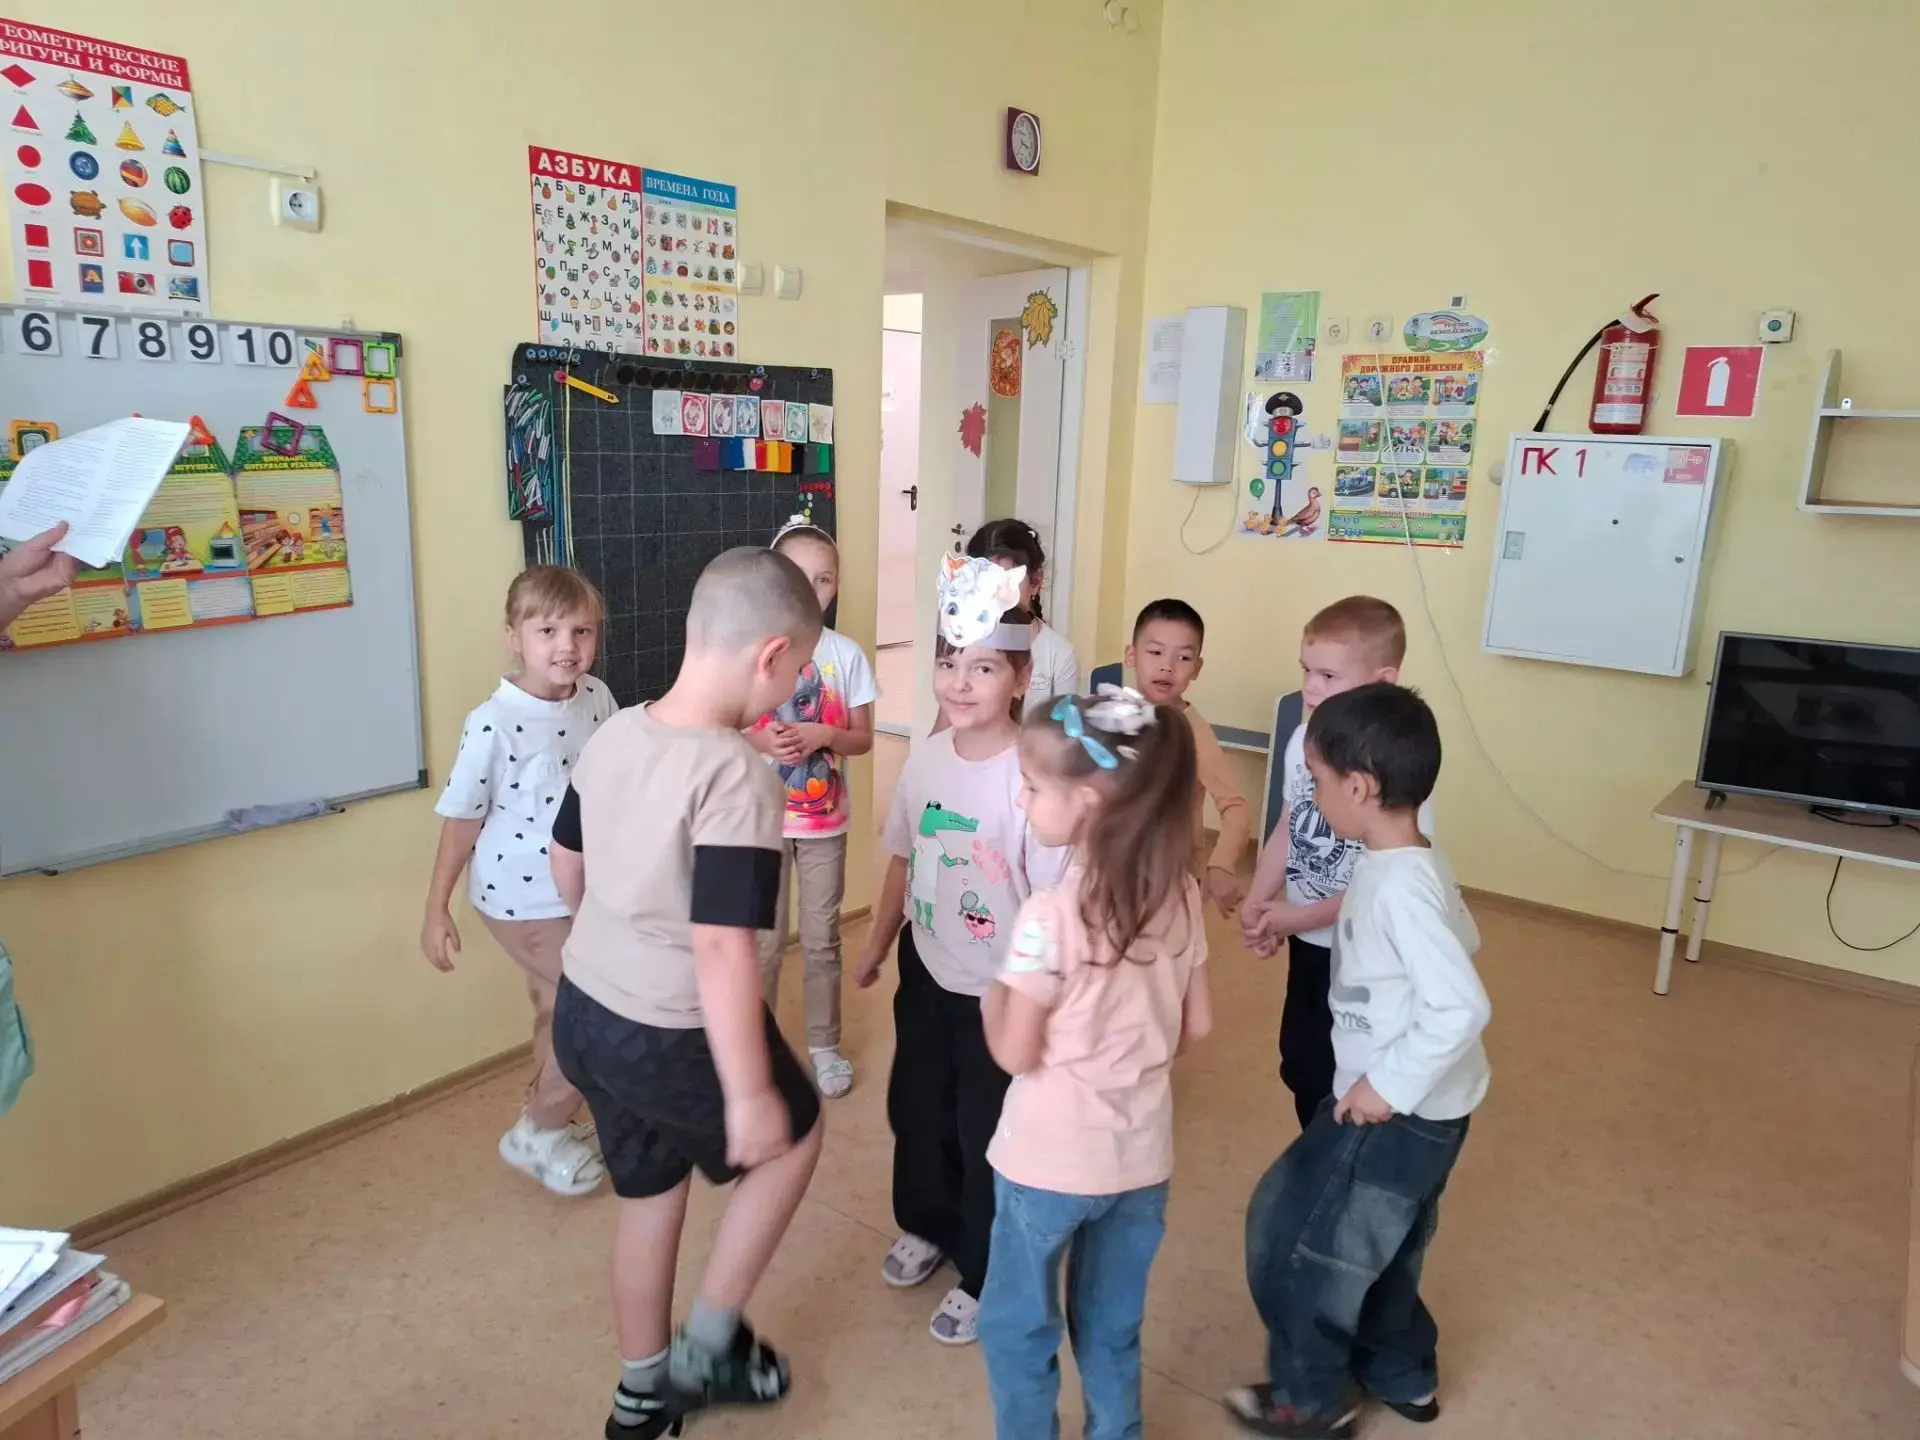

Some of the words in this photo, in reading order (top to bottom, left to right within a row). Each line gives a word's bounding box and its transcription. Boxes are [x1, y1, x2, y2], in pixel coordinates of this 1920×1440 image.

[88, 57, 104, 71] И
[109, 62, 184, 88] ФОРМЫ
[538, 152, 632, 187] АЗБУКА
[534, 176, 542, 188] А
[556, 180, 563, 191] Б
[579, 185, 586, 195] В
[601, 189, 607, 199] Г
[622, 192, 631, 205] Д
[646, 176, 698, 198] ВРЕМЕНА
[703, 187, 730, 204] ГОДА
[535, 203, 542, 215] Е
[580, 211, 589, 223] Ж
[602, 215, 609, 226] З
[623, 218, 631, 229] И
[559, 234, 566, 245] К
[581, 237, 589, 248] Л
[603, 241, 612, 252] М
[624, 243, 631, 255] Н
[538, 257, 546, 269] О
[560, 260, 568, 272] П
[582, 263, 588, 274] Р
[603, 266, 610, 277] С
[624, 268, 631, 279] Т
[539, 284, 546, 295] У
[560, 286, 570, 297] Ф
[583, 289, 590, 300] Х
[604, 291, 612, 305] Ц
[625, 293, 632, 304] Ч
[541, 310, 551, 322] Ш
[562, 312, 573, 326] Щ
[605, 316, 615, 327] Ы
[626, 318, 633, 329] Ь
[21, 312, 53, 352] 6
[82, 316, 110, 355] 7
[138, 321, 167, 358] 8
[187, 324, 215, 360] 9
[237, 328, 293, 366] 10
[585, 339, 596, 350] Ю
[606, 341, 613, 351] Я
[1521, 447, 1560, 476] ПК
[1575, 448, 1588, 478] 1
